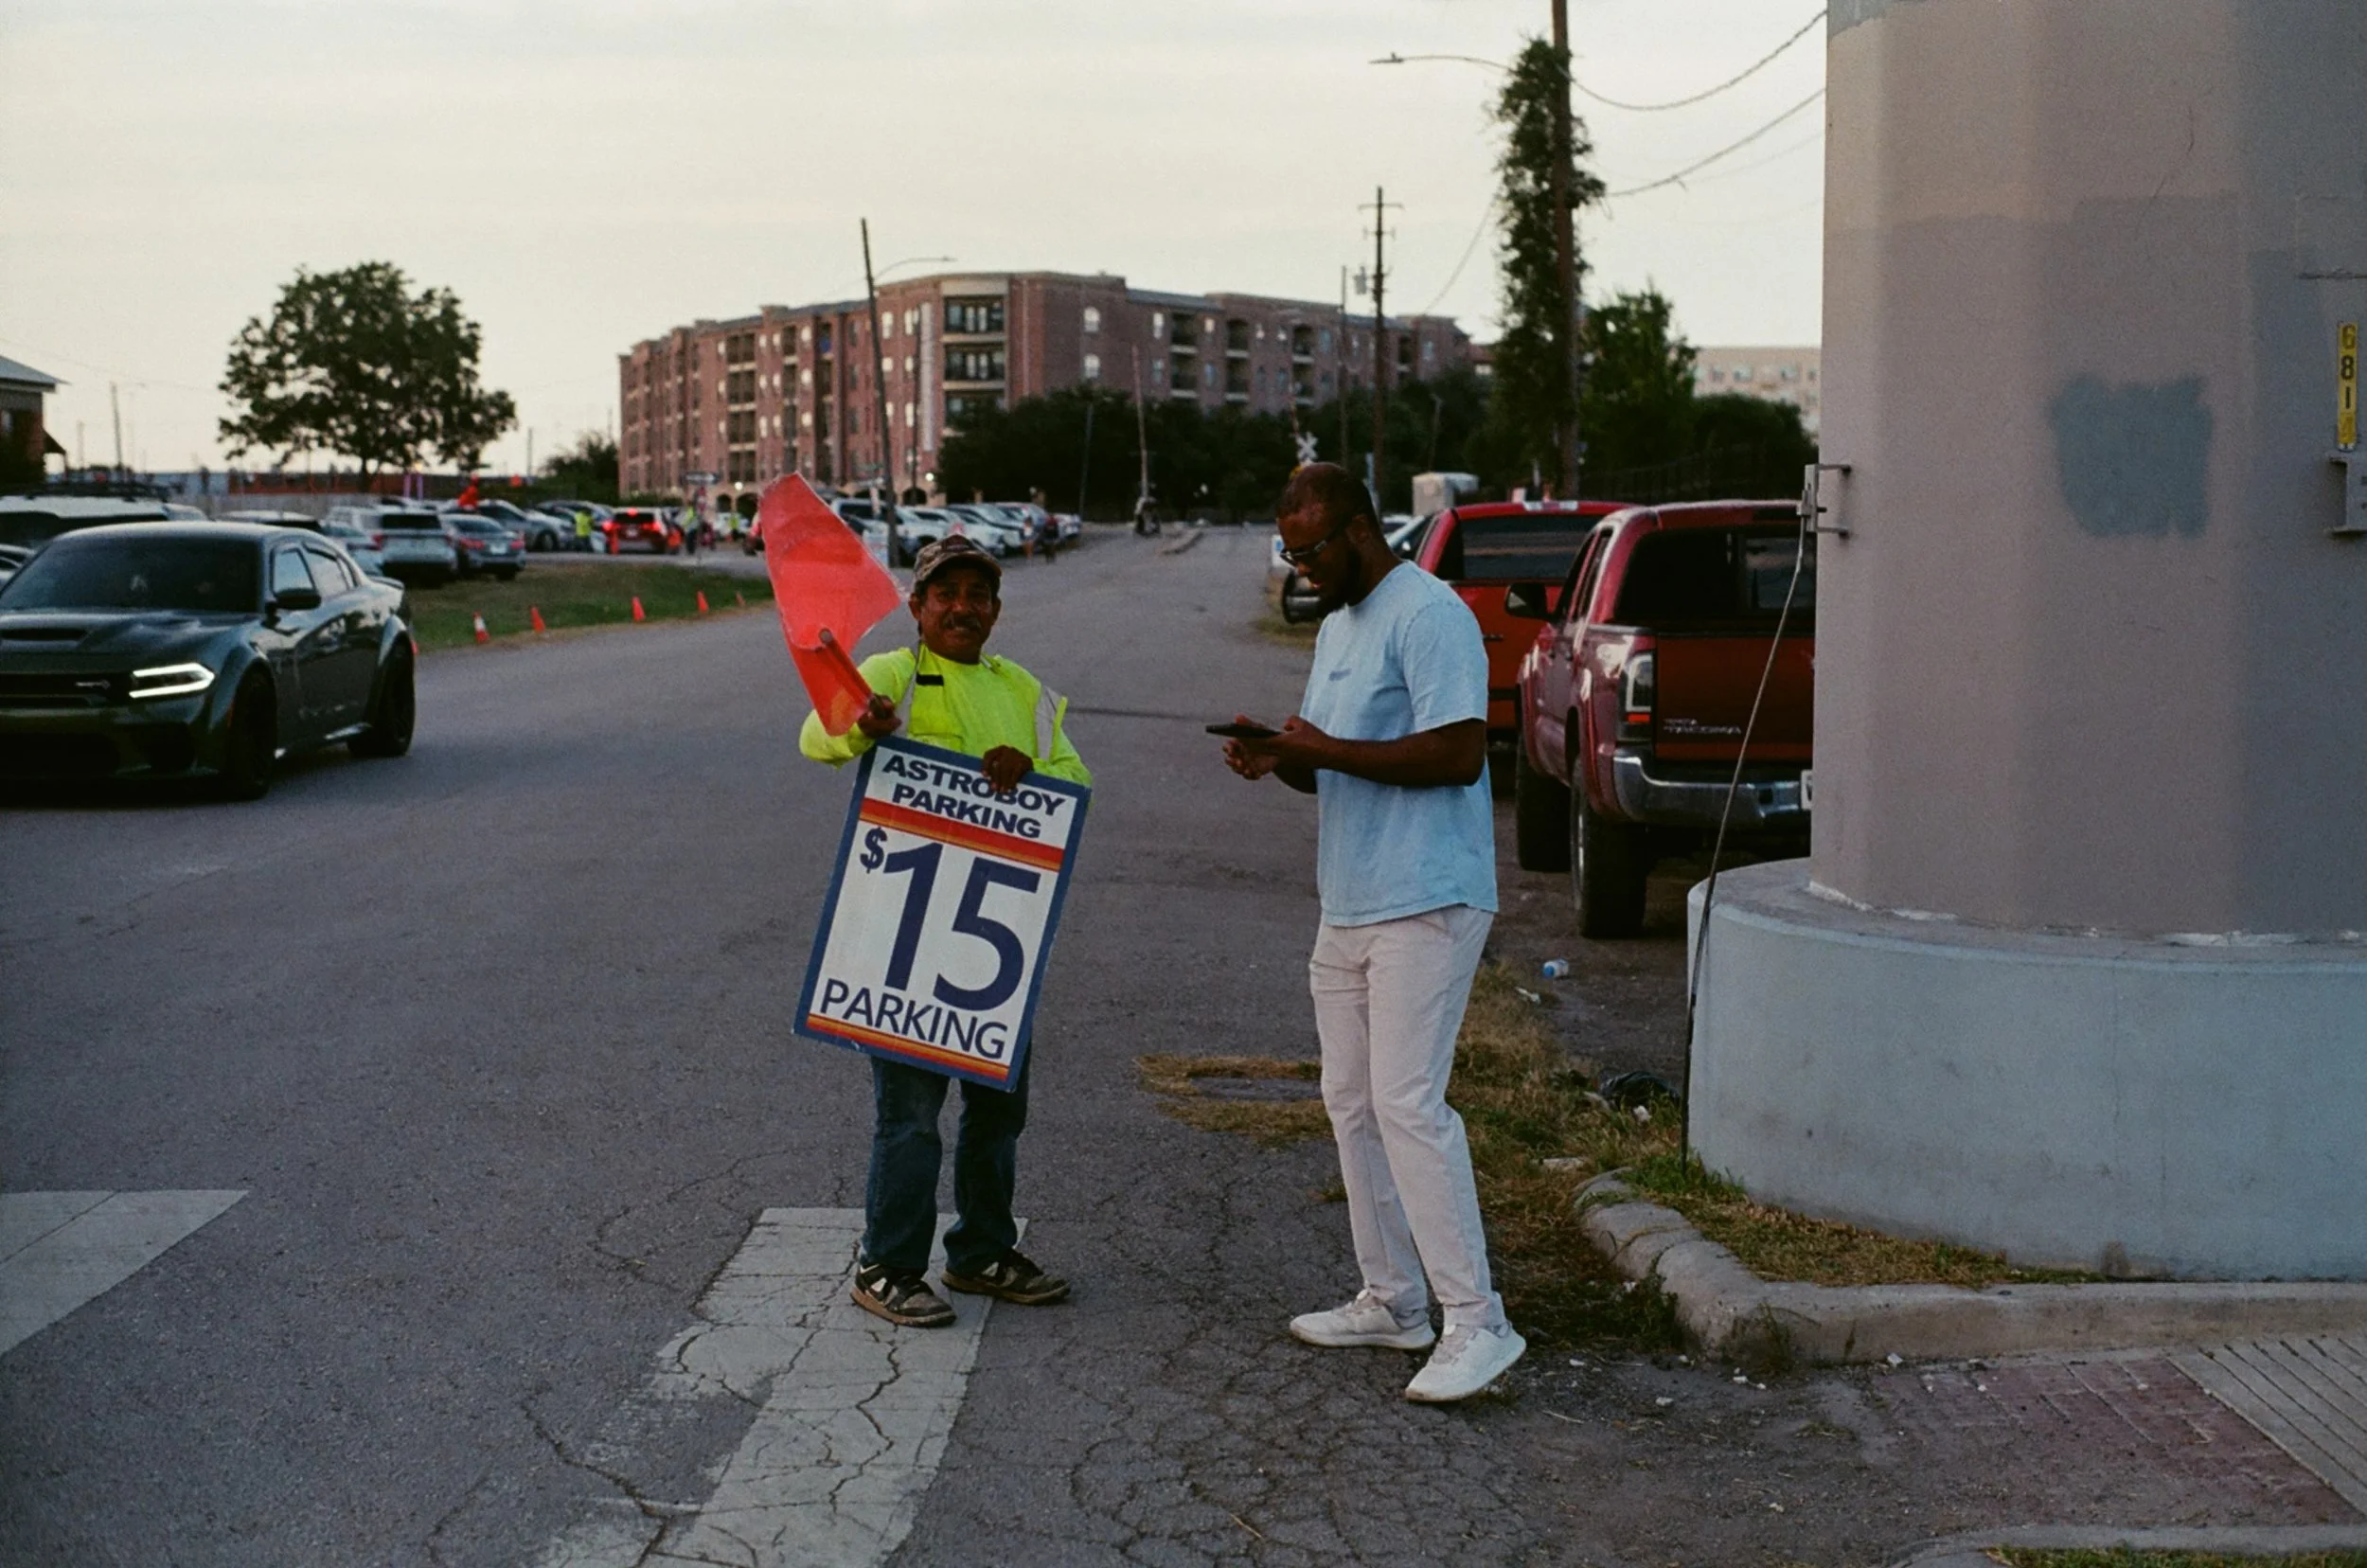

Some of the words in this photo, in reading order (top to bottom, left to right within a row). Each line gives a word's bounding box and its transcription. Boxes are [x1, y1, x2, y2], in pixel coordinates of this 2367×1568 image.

[881, 754, 1065, 816] ASTROBOY
[892, 783, 1041, 840] PARKING
[859, 827, 1041, 1012] $15
[820, 977, 1009, 1060] PARKING
